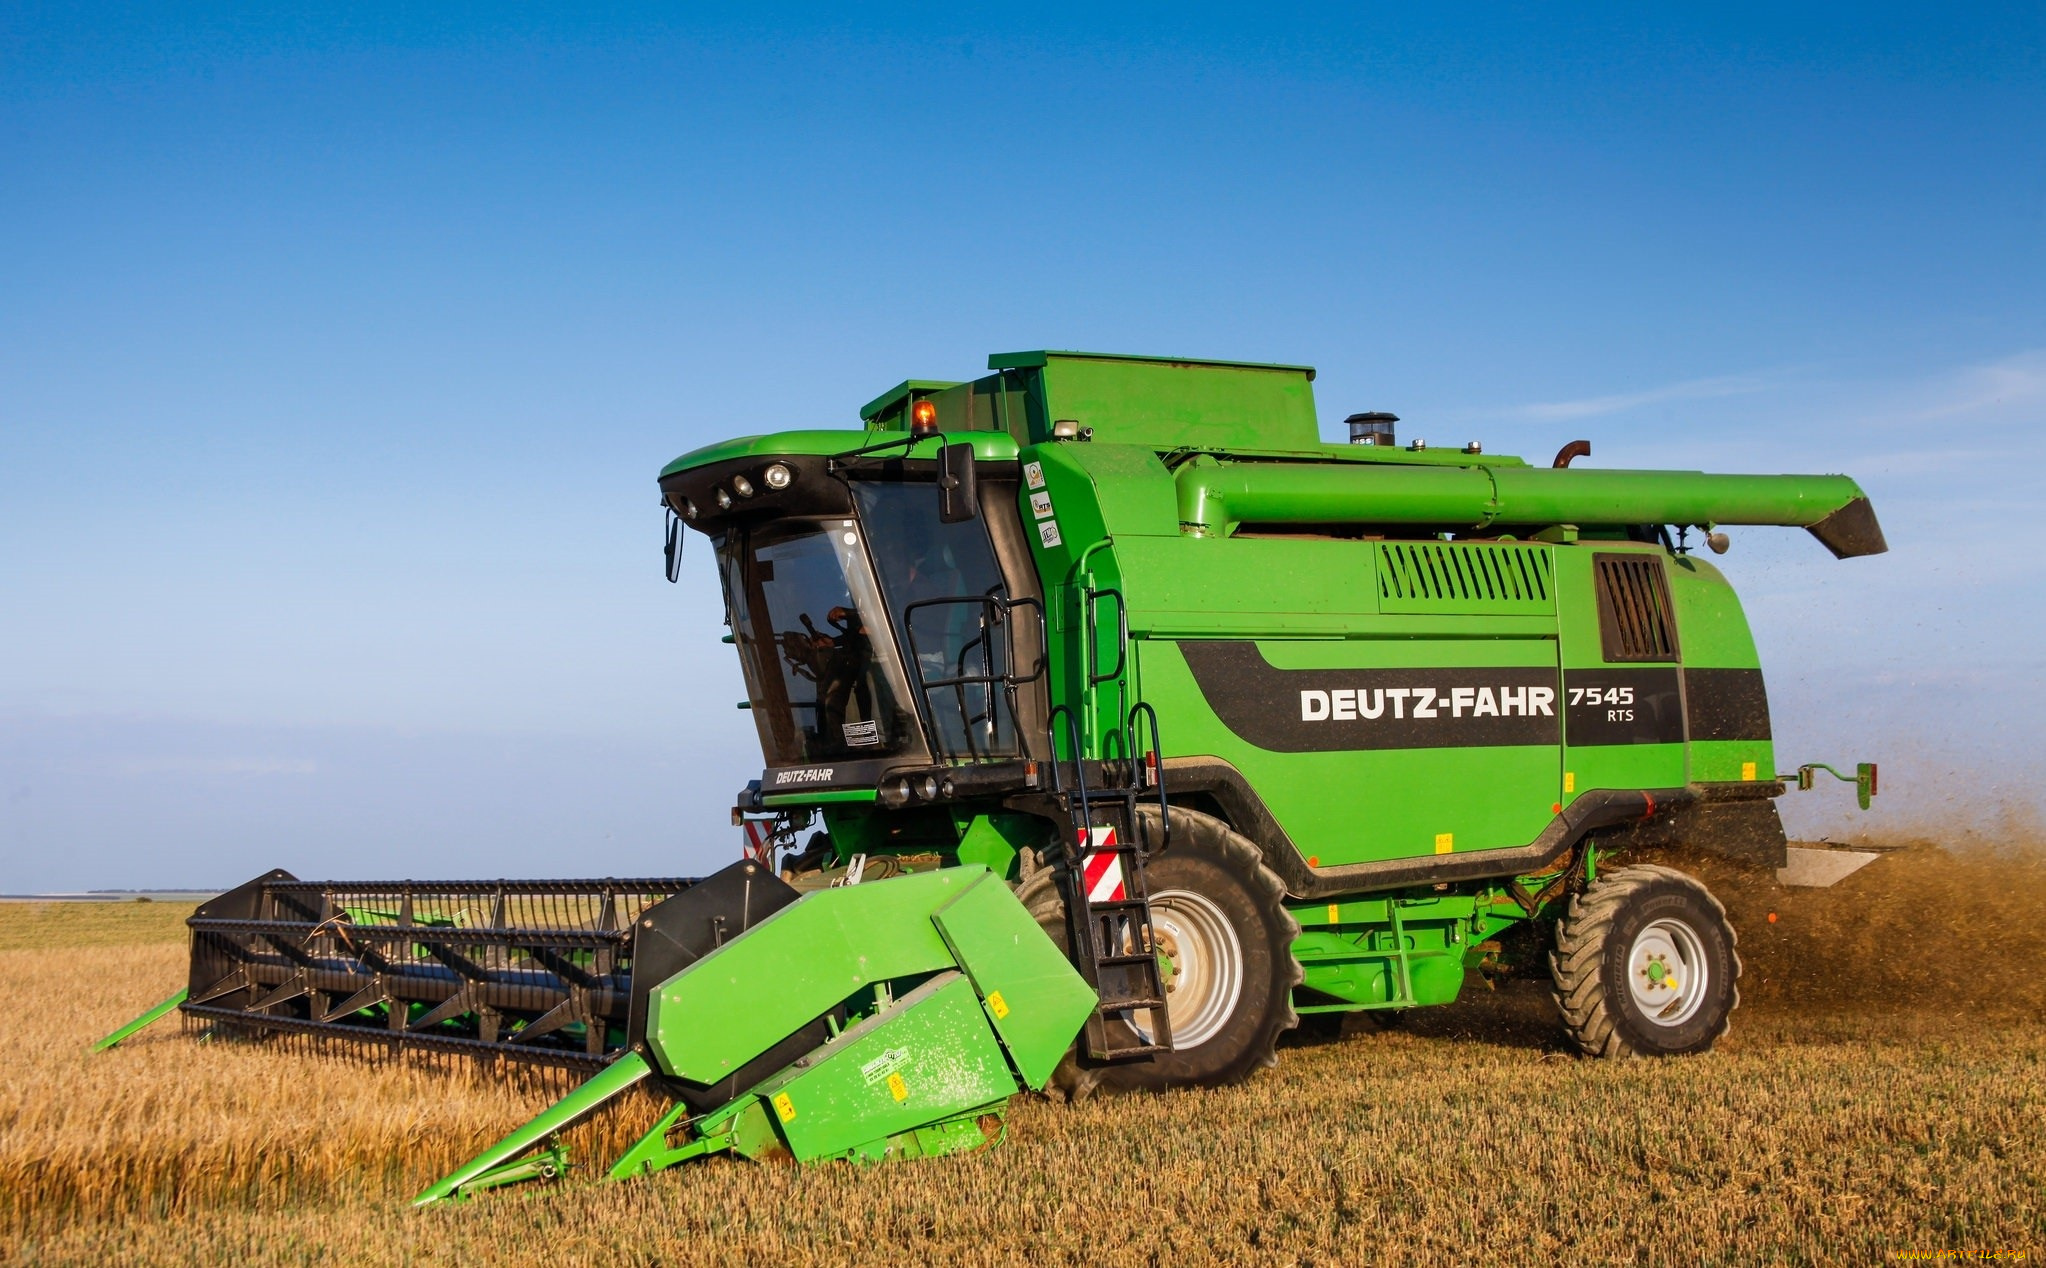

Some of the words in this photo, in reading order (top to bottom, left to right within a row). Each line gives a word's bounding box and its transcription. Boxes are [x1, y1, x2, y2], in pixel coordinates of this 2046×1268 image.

[1300, 686, 1555, 722] DEUTZ-FAHR
[1568, 687, 1634, 706] 7545
[1607, 709, 1634, 722] RTS
[775, 768, 834, 785] DEUTZ-FAHR
[1614, 946, 1627, 1005] MICHELIN
